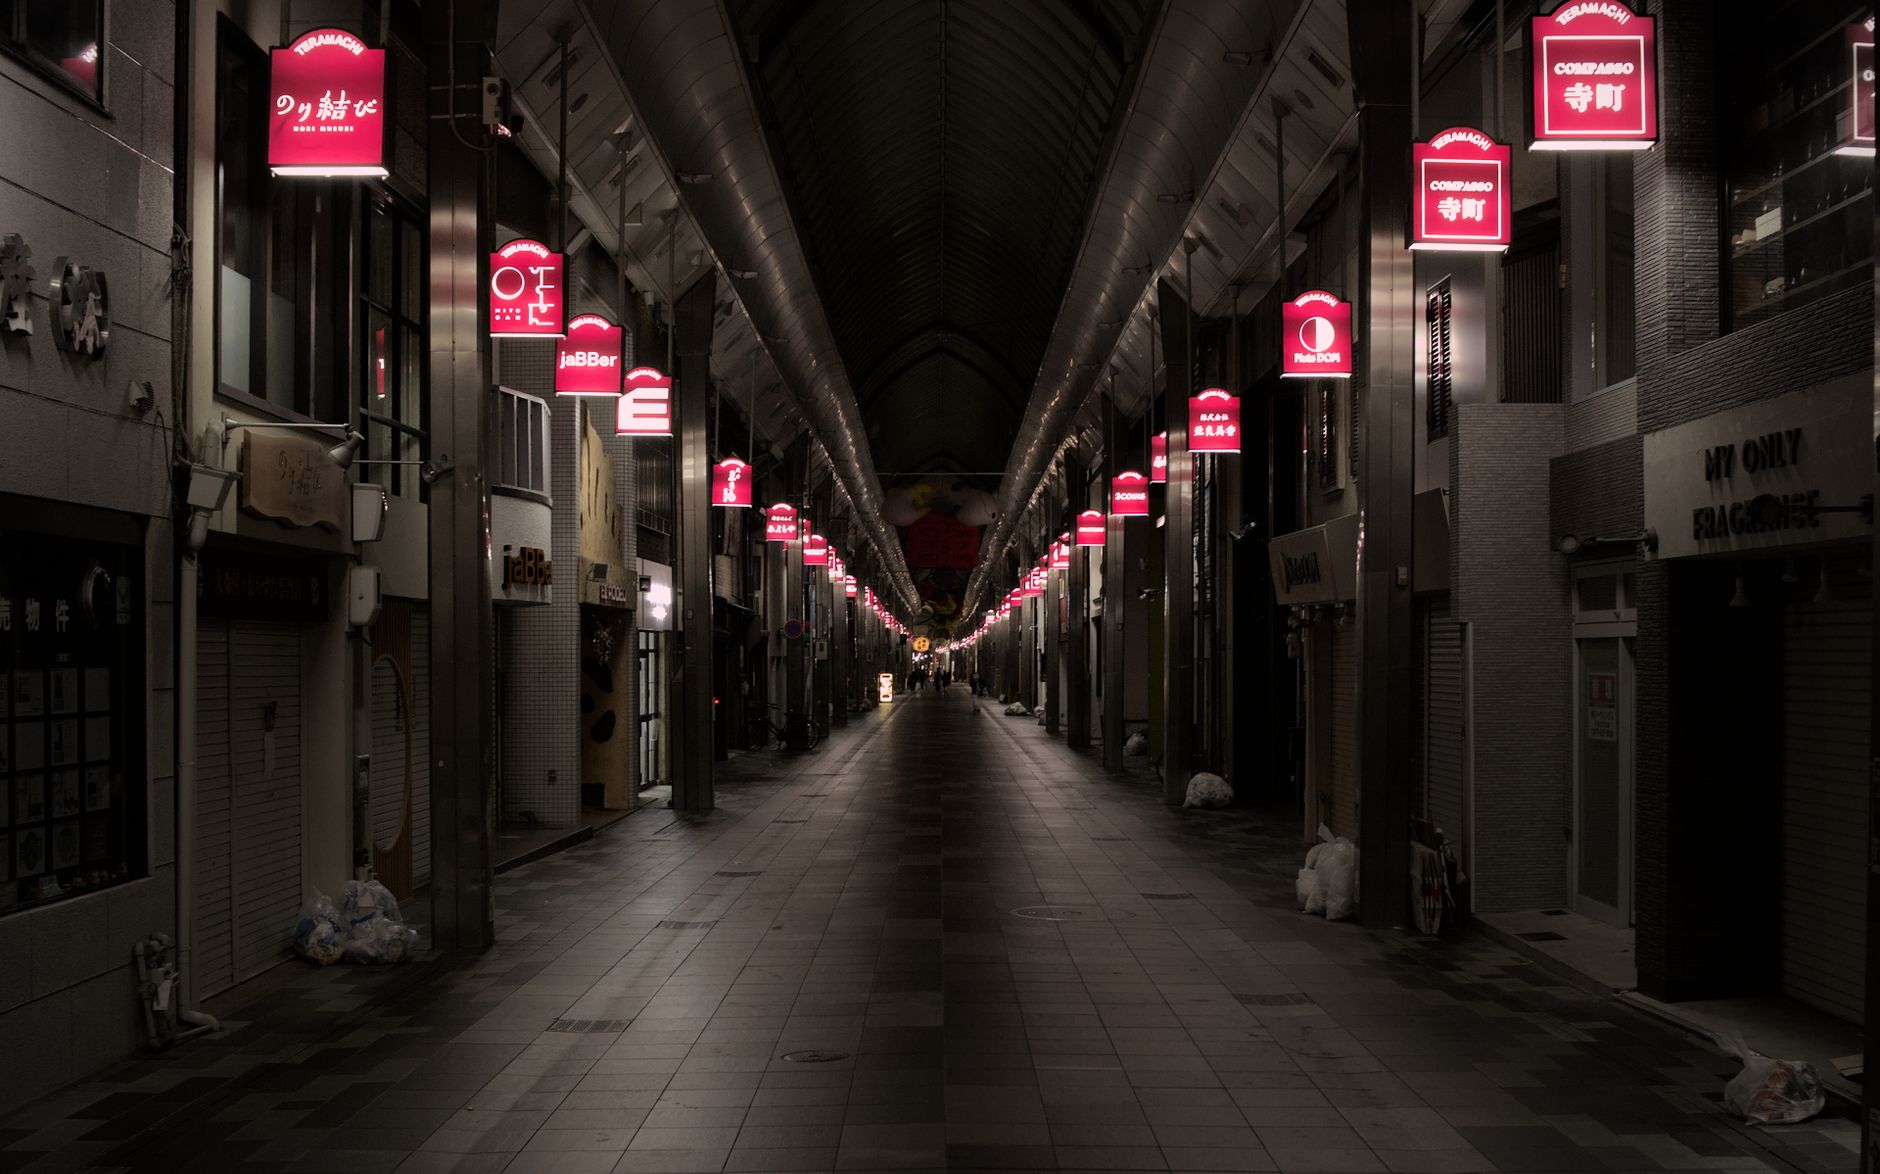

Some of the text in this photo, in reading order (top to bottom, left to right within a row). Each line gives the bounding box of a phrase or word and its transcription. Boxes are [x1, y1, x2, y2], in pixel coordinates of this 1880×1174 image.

[1555, 2, 1631, 26] TERAMACHI
[293, 34, 364, 56] TERAMACHI
[1553, 62, 1635, 76] COMPASSO
[276, 89, 378, 123] のり結び
[1563, 82, 1626, 113] 寺町
[1431, 131, 1492, 152] TERAMACHI
[1429, 180, 1494, 193] COMPASSO
[1437, 196, 1487, 222] 寺町
[500, 243, 549, 259] TERAMACHI
[559, 351, 618, 370] jaBBer
[1705, 428, 1801, 481] MY ONLY
